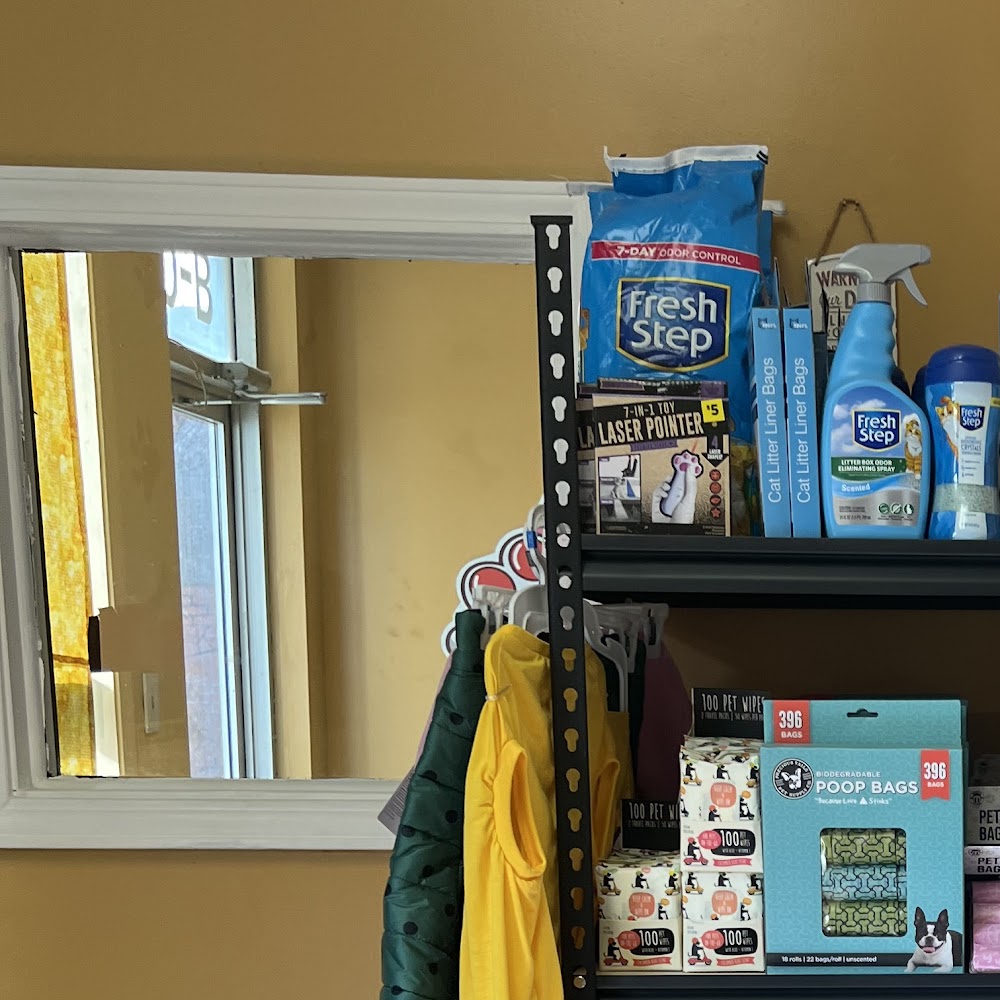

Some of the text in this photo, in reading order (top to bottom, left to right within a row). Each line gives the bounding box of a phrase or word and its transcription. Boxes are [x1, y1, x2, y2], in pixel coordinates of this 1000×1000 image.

[617, 245, 742, 266] 7-DAY ODOR CONTROL
[629, 290, 717, 324] Fresh
[631, 319, 713, 358] Step
[623, 400, 675, 418] 7-IN-1 TOY
[961, 407, 983, 418] Fresh
[598, 418, 644, 445] LASER
[645, 411, 704, 440] POINTER
[762, 356, 782, 503] Cat Litter Liner Bags
[857, 413, 897, 429] Fresh
[962, 416, 981, 428] Step
[793, 357, 811, 504] Cat Litter Liner Bags
[859, 427, 895, 446] Step
[877, 465, 896, 473] SPRAY
[841, 483, 871, 493] Scented
[701, 693, 719, 712] 100
[722, 694, 738, 712] PET
[779, 710, 803, 729] 396
[780, 731, 803, 739] BAGS
[923, 761, 947, 780] 396
[816, 780, 918, 795] POOP BAGS
[979, 809, 1000, 824] PET
[720, 829, 740, 847] 100
[977, 857, 1000, 865] PET
[638, 929, 659, 946] 100
[723, 929, 743, 946] 100
